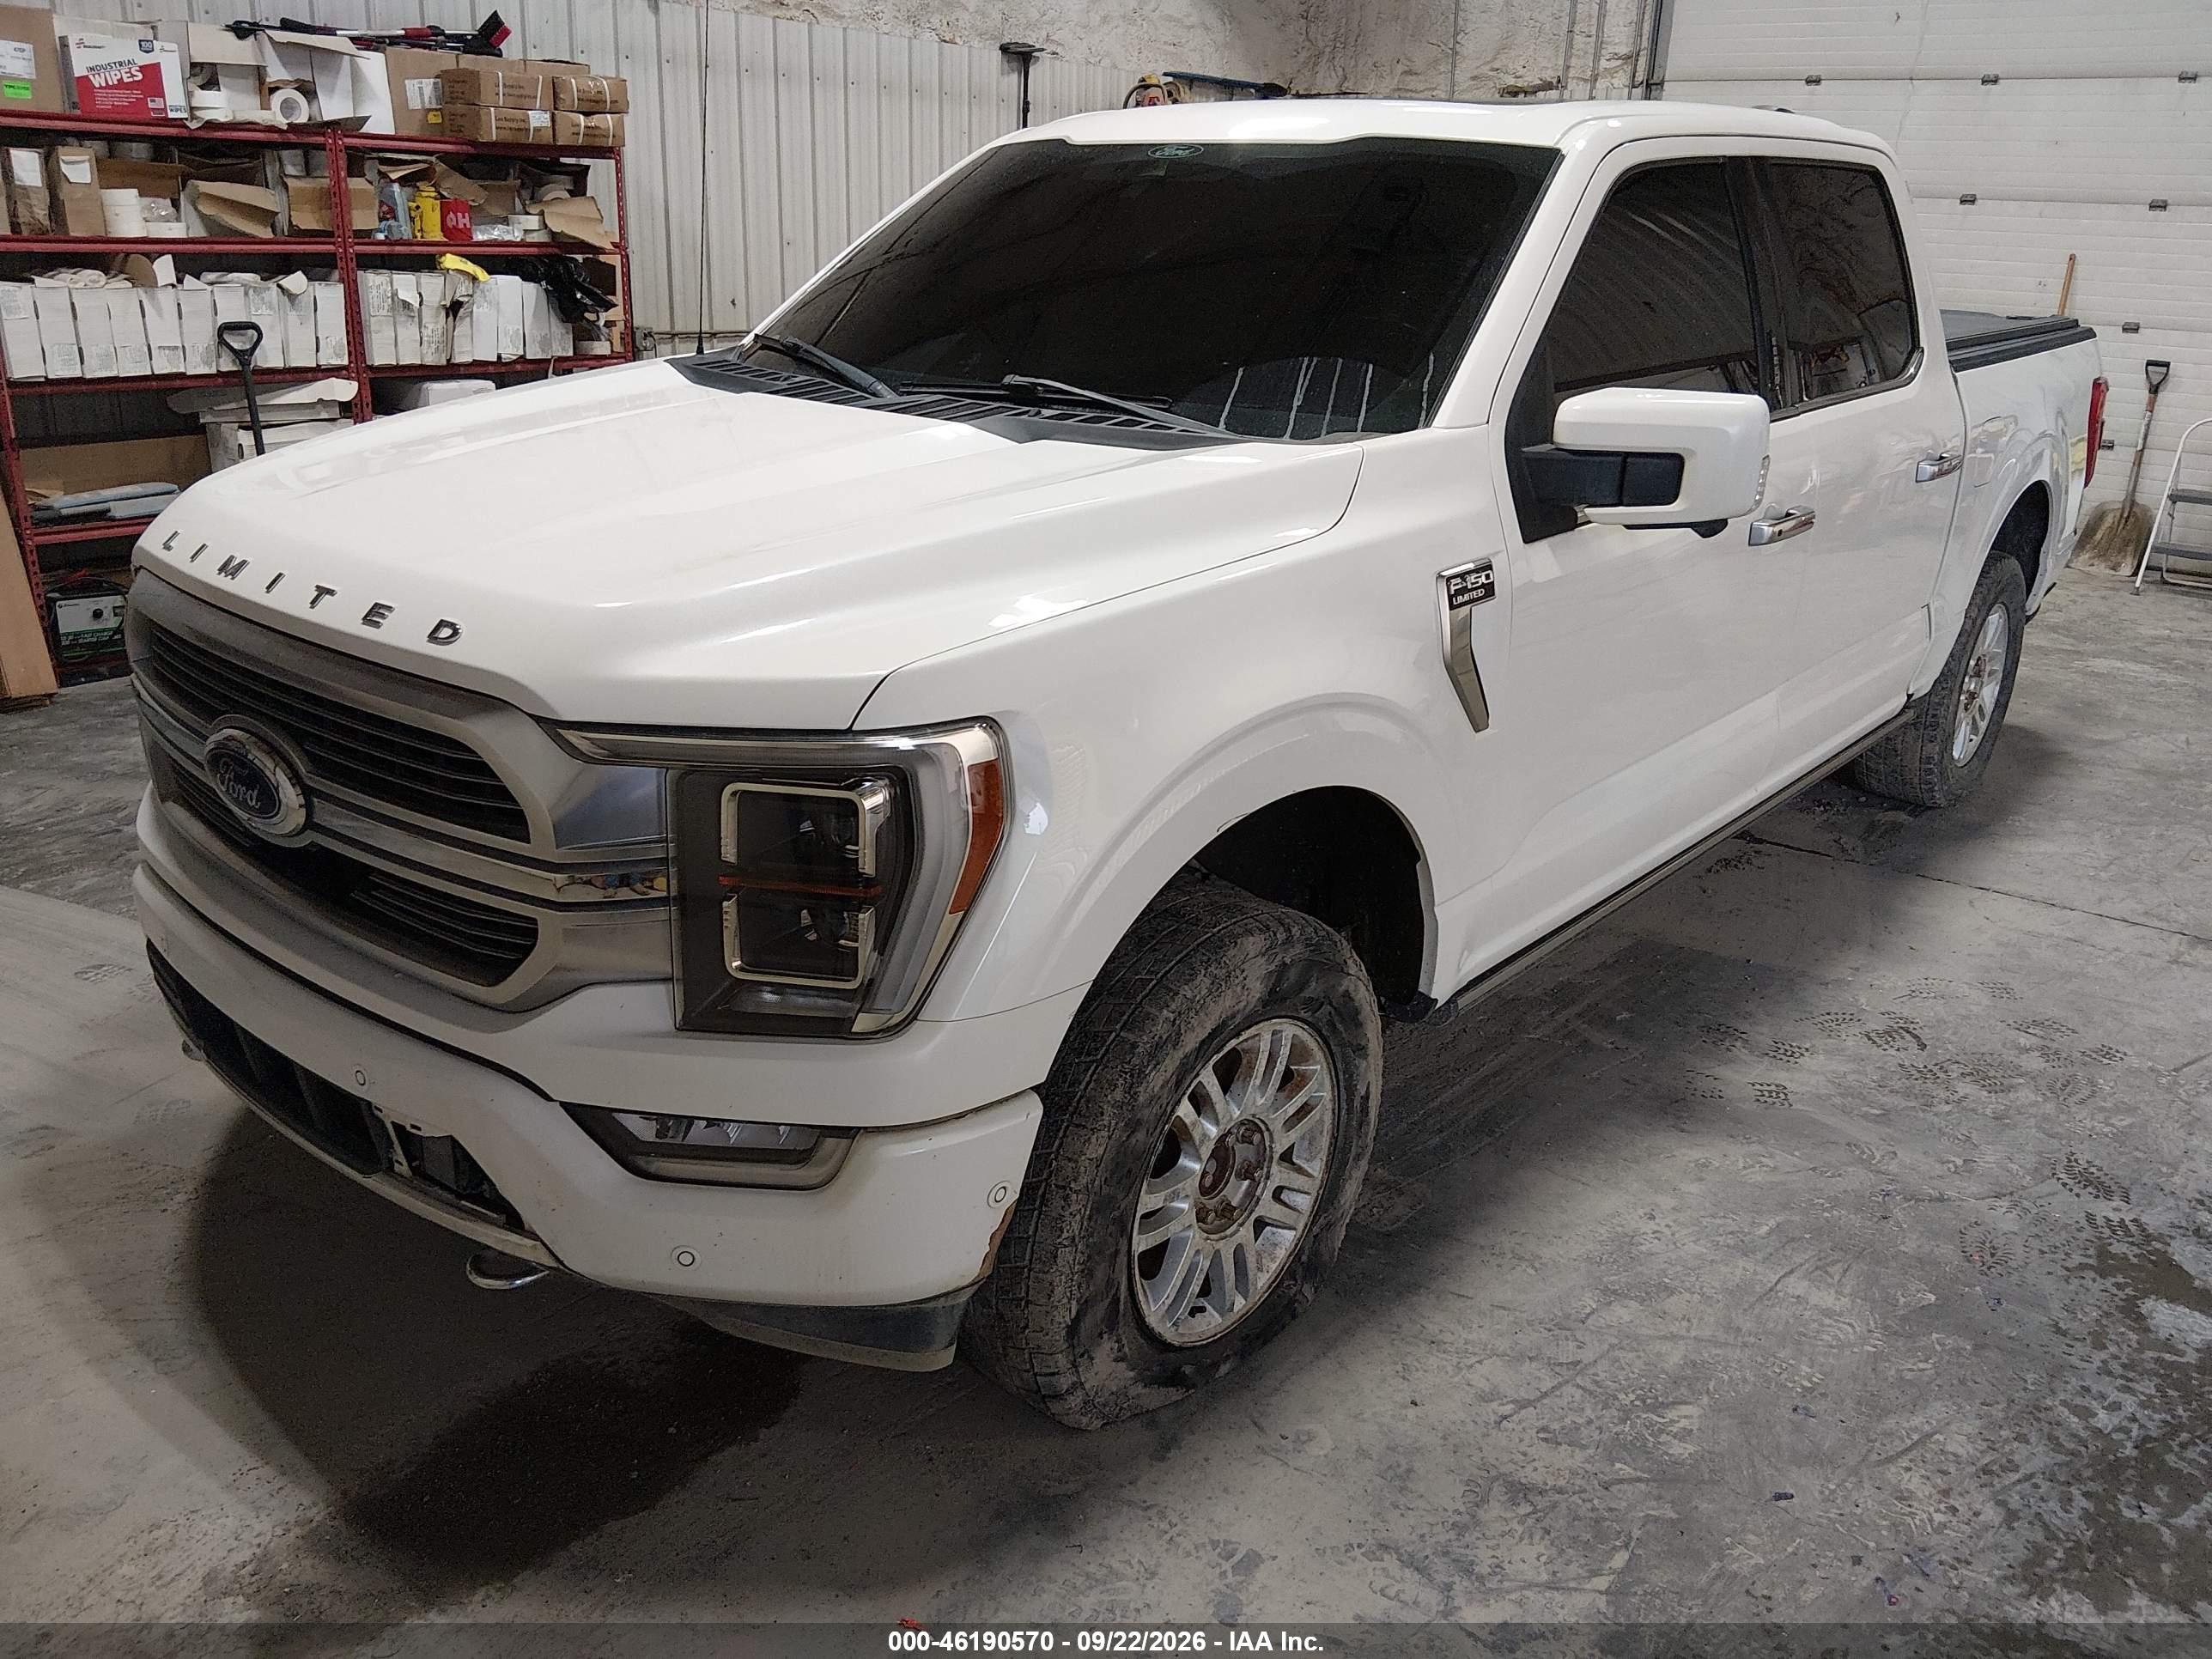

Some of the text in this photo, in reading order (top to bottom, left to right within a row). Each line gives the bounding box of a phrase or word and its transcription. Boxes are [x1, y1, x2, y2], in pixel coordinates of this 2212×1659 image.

[86, 58, 137, 73] INDUSTRIAL
[88, 66, 143, 88] WIPES
[162, 530, 464, 646] LIMITED
[1448, 569, 1494, 594] F-150
[1452, 588, 1486, 605] LIMITED
[216, 757, 261, 809] Ford
